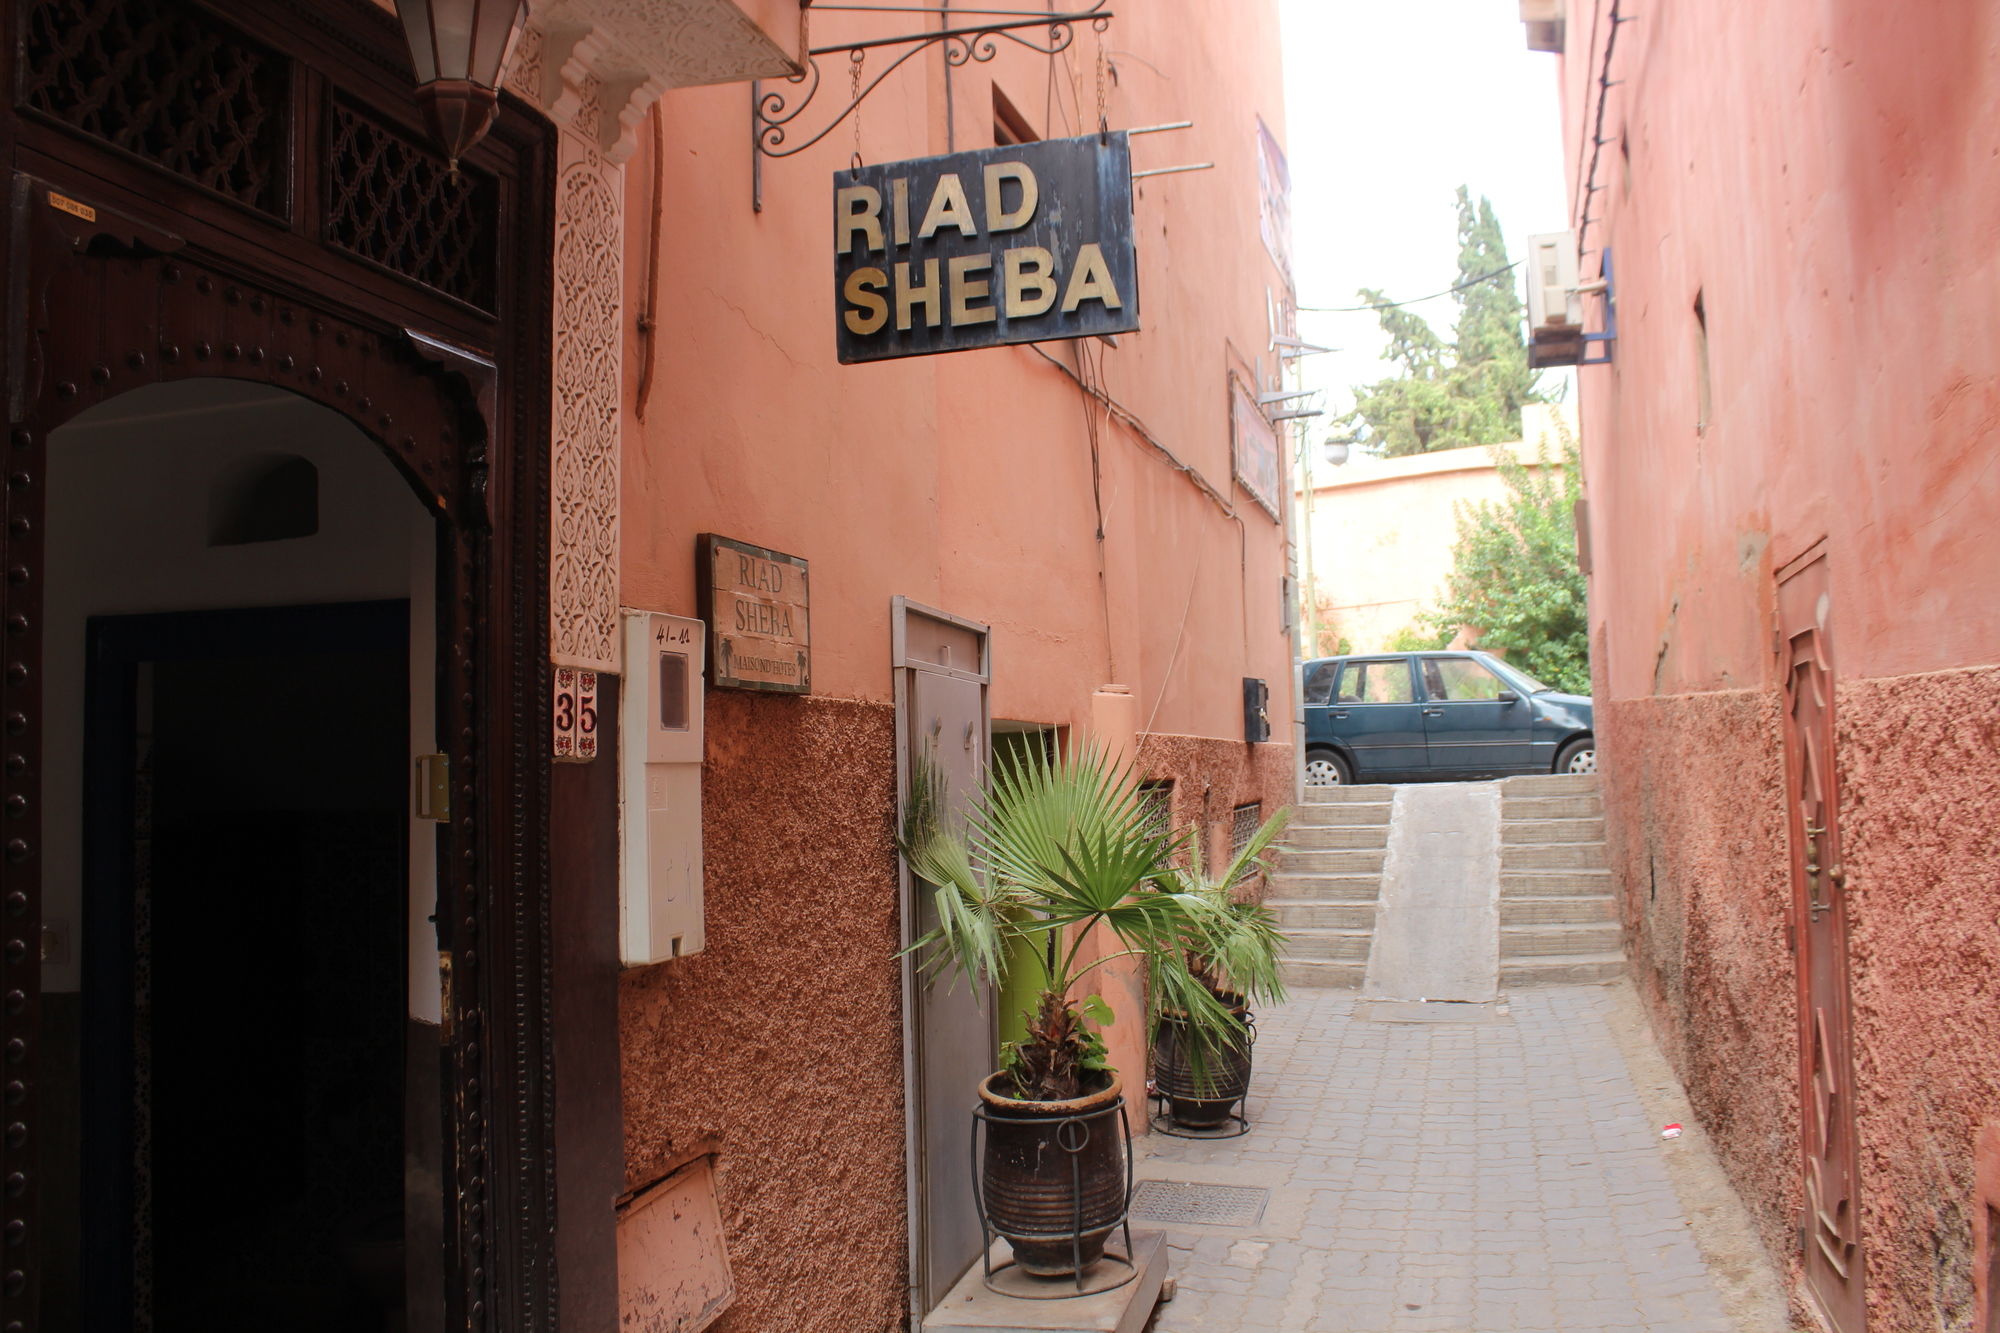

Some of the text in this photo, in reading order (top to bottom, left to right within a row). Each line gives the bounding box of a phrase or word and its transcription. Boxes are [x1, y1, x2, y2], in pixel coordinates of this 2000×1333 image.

[837, 161, 1039, 255] RIAD
[843, 241, 1122, 335] SHEBA
[738, 554, 783, 593] RIAD
[735, 599, 794, 638] SHEBA
[733, 655, 766, 672] MAISON
[556, 692, 597, 734] 35
